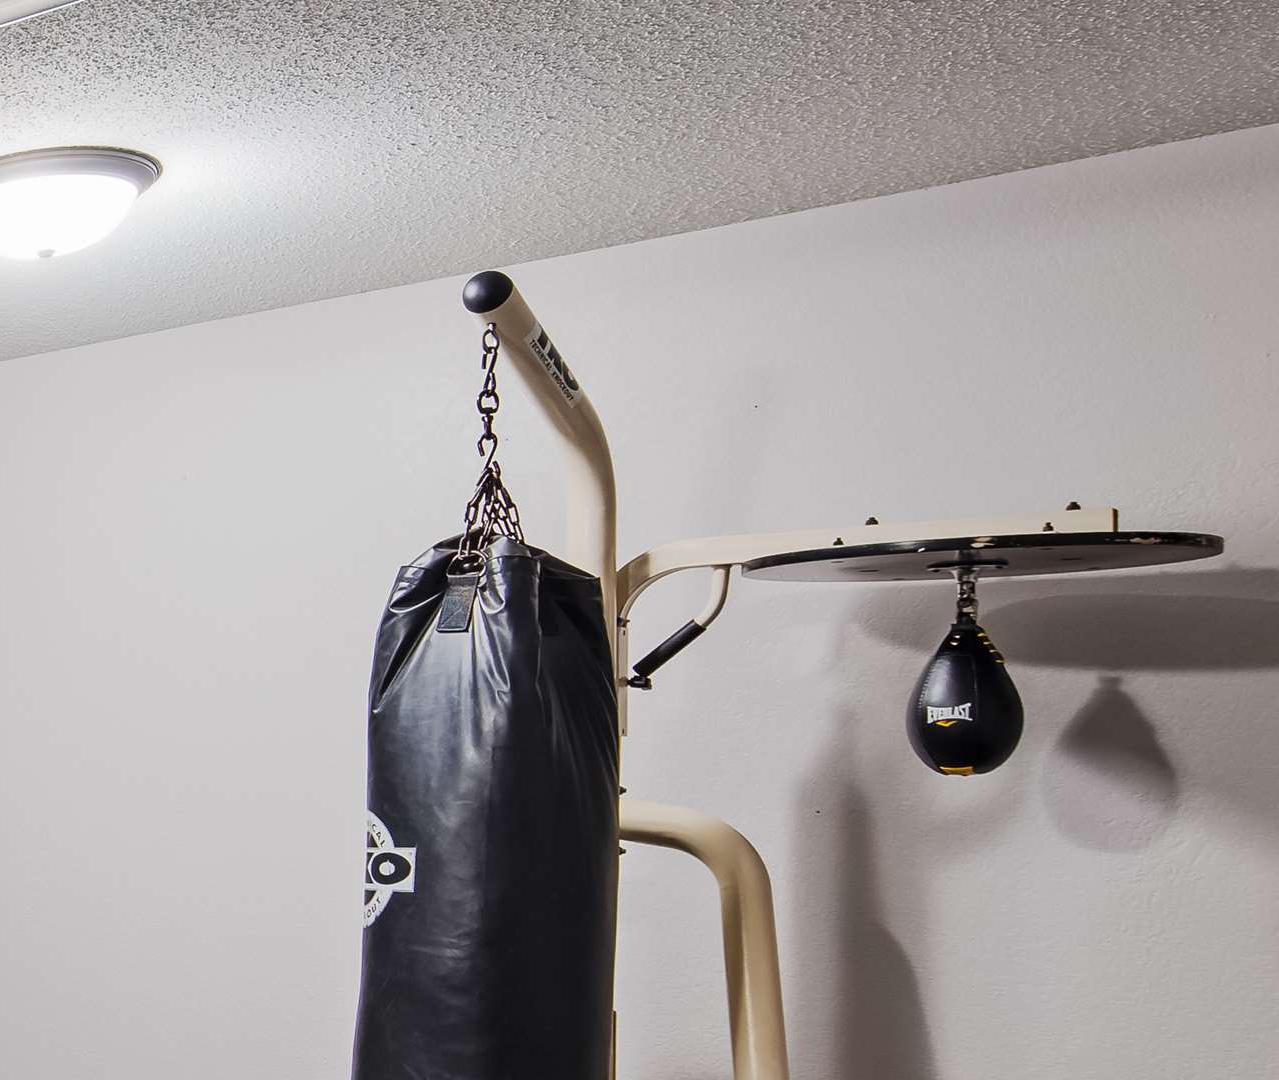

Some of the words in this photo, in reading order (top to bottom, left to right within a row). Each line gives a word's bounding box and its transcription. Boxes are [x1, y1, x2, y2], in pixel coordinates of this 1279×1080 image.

[529, 339, 552, 371] TECHNICAL
[551, 371, 574, 401] KNOCKOUT
[927, 703, 973, 724] EVERLAST
